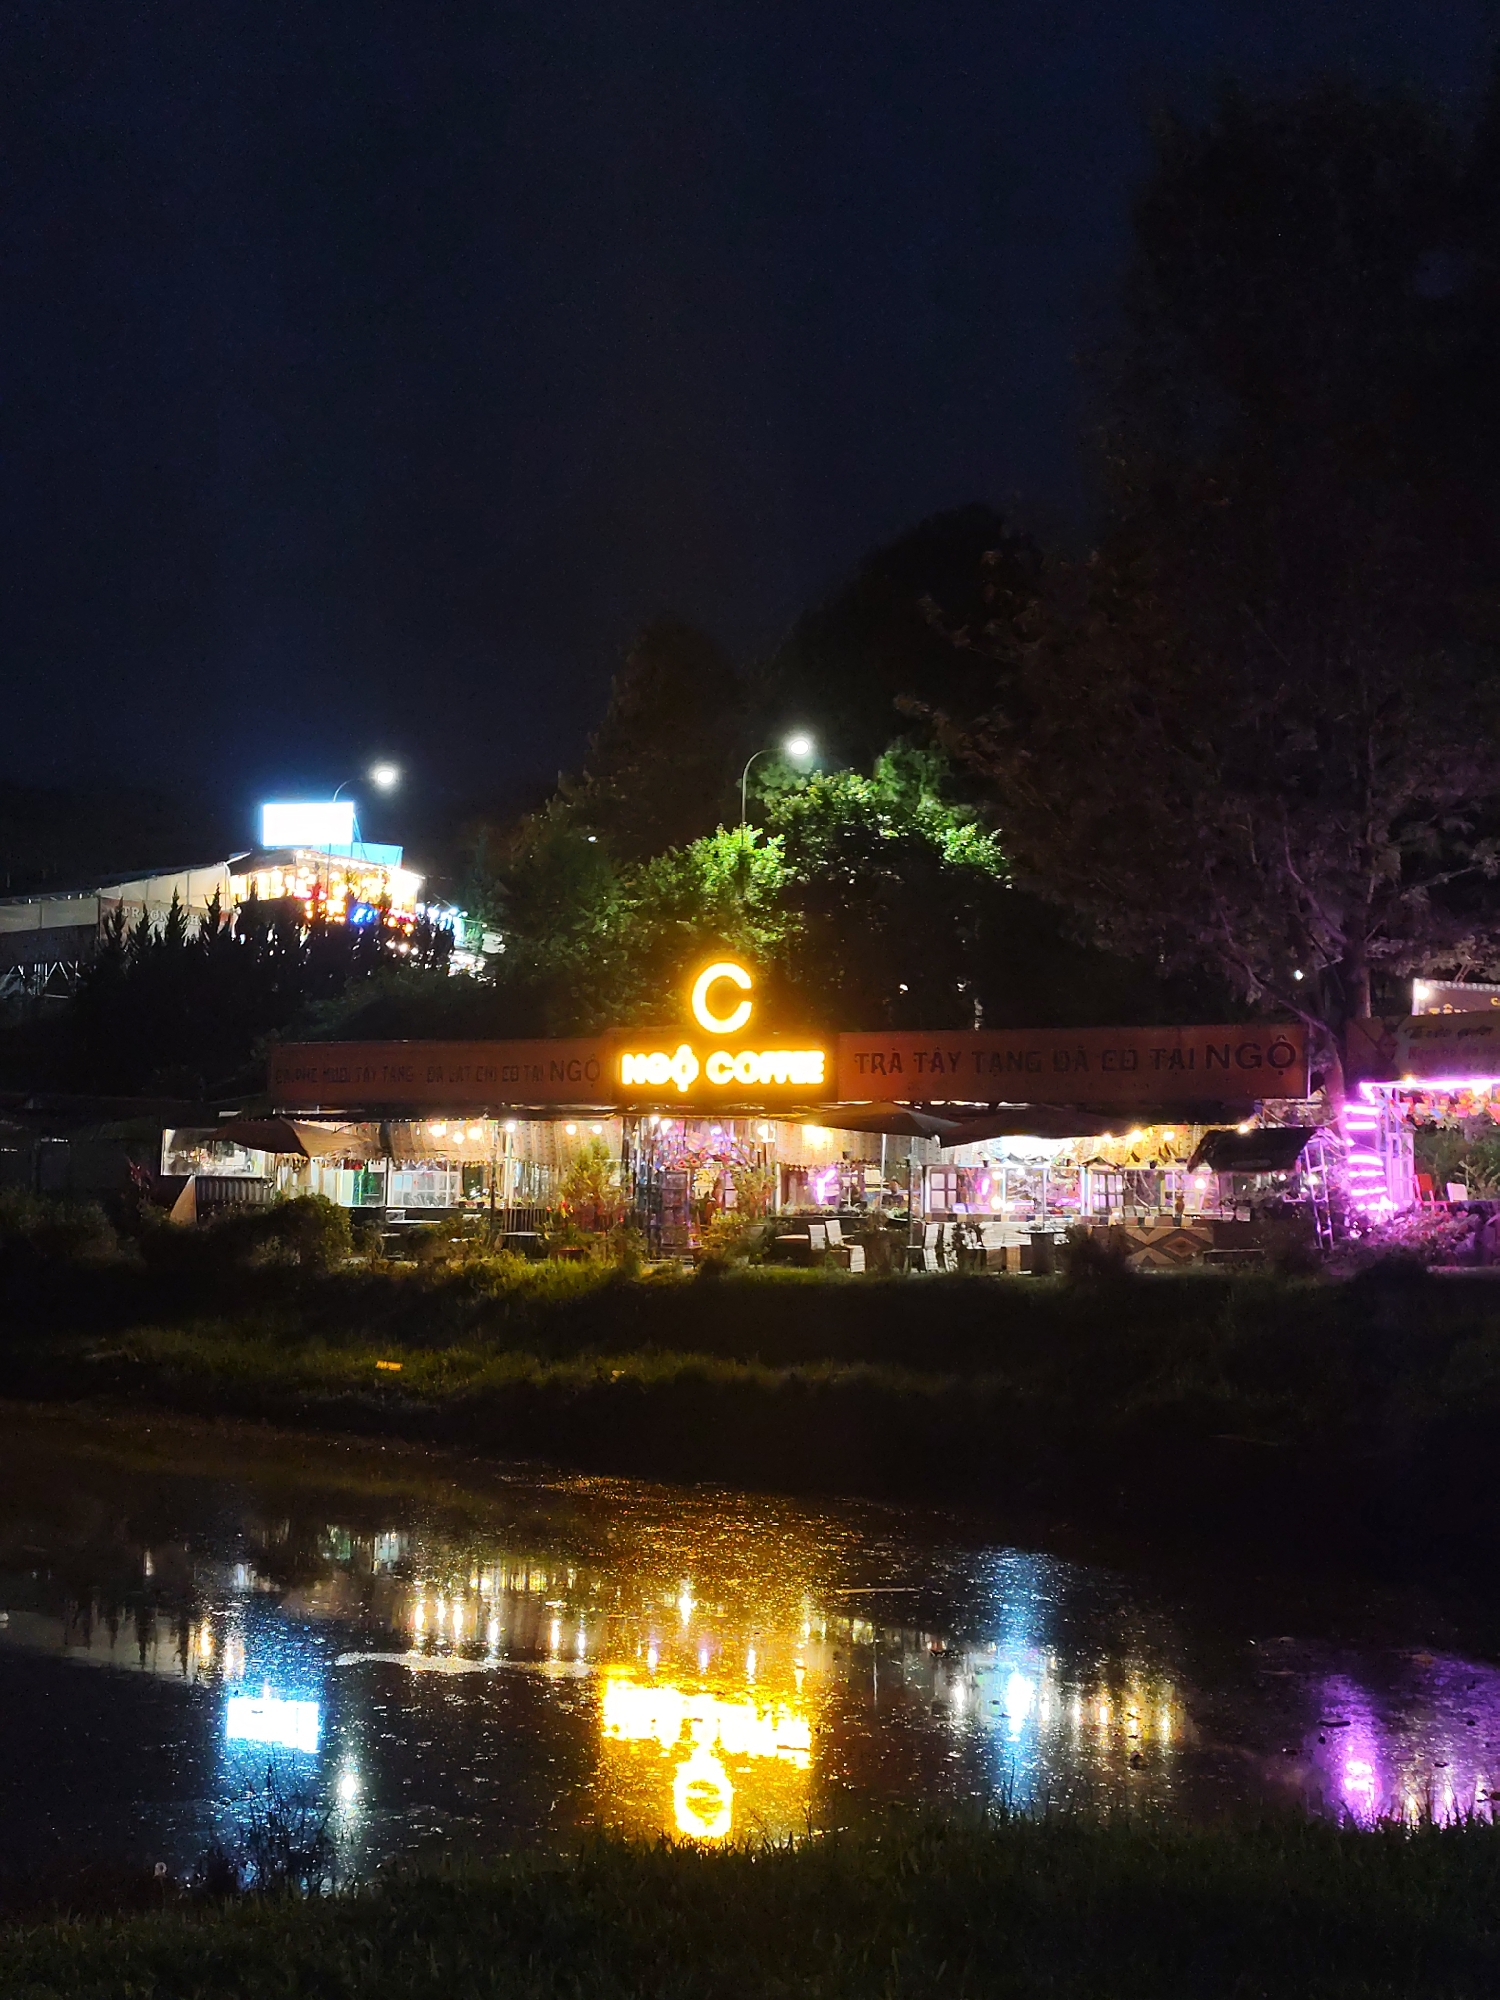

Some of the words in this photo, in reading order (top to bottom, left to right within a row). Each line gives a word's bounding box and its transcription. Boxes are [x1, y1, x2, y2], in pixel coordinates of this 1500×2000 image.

[692, 962, 753, 1034] C
[550, 1053, 600, 1088] NGỘ
[706, 1050, 825, 1086] COFFEE
[854, 1047, 903, 1076] TRÀ
[1206, 1034, 1296, 1076] NGỘ
